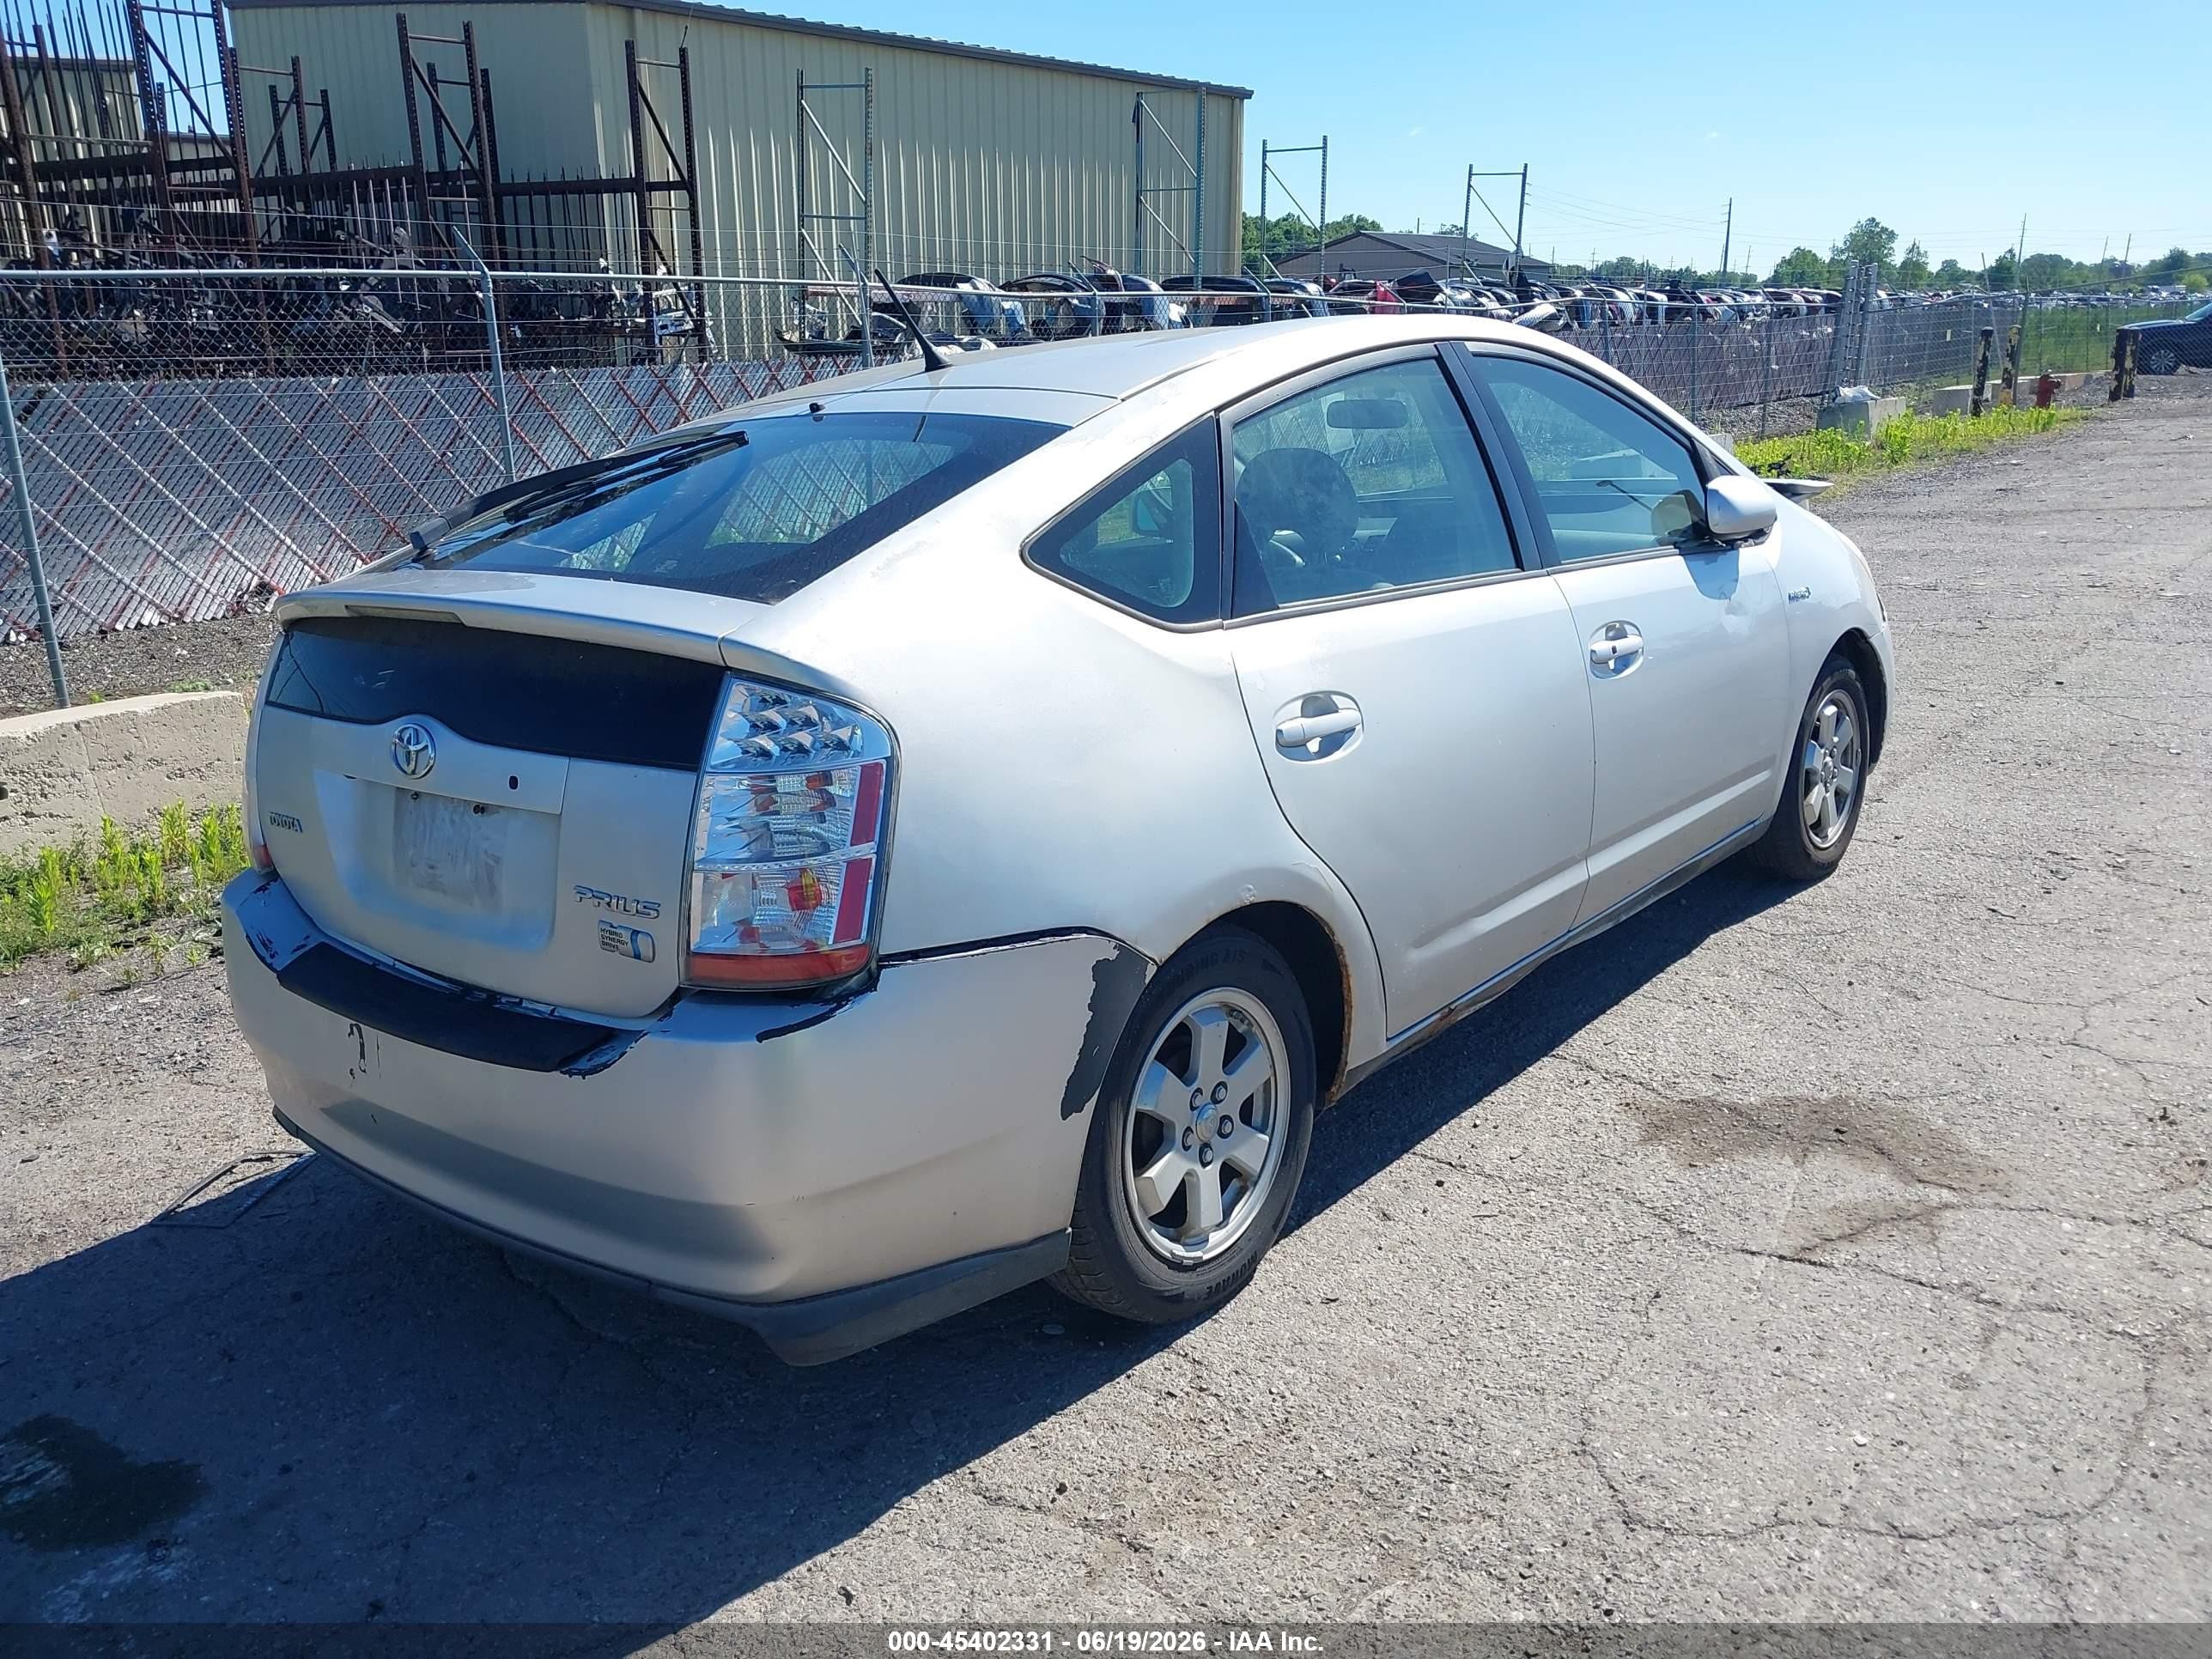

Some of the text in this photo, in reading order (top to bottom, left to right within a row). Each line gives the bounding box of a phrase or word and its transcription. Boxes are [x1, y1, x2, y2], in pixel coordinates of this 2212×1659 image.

[268, 811, 303, 833] TOYOTA
[574, 884, 661, 920] PRIUS
[600, 927, 623, 939] HYBRID
[600, 933, 629, 947] SYNERGY
[601, 940, 620, 951] DRIVE
